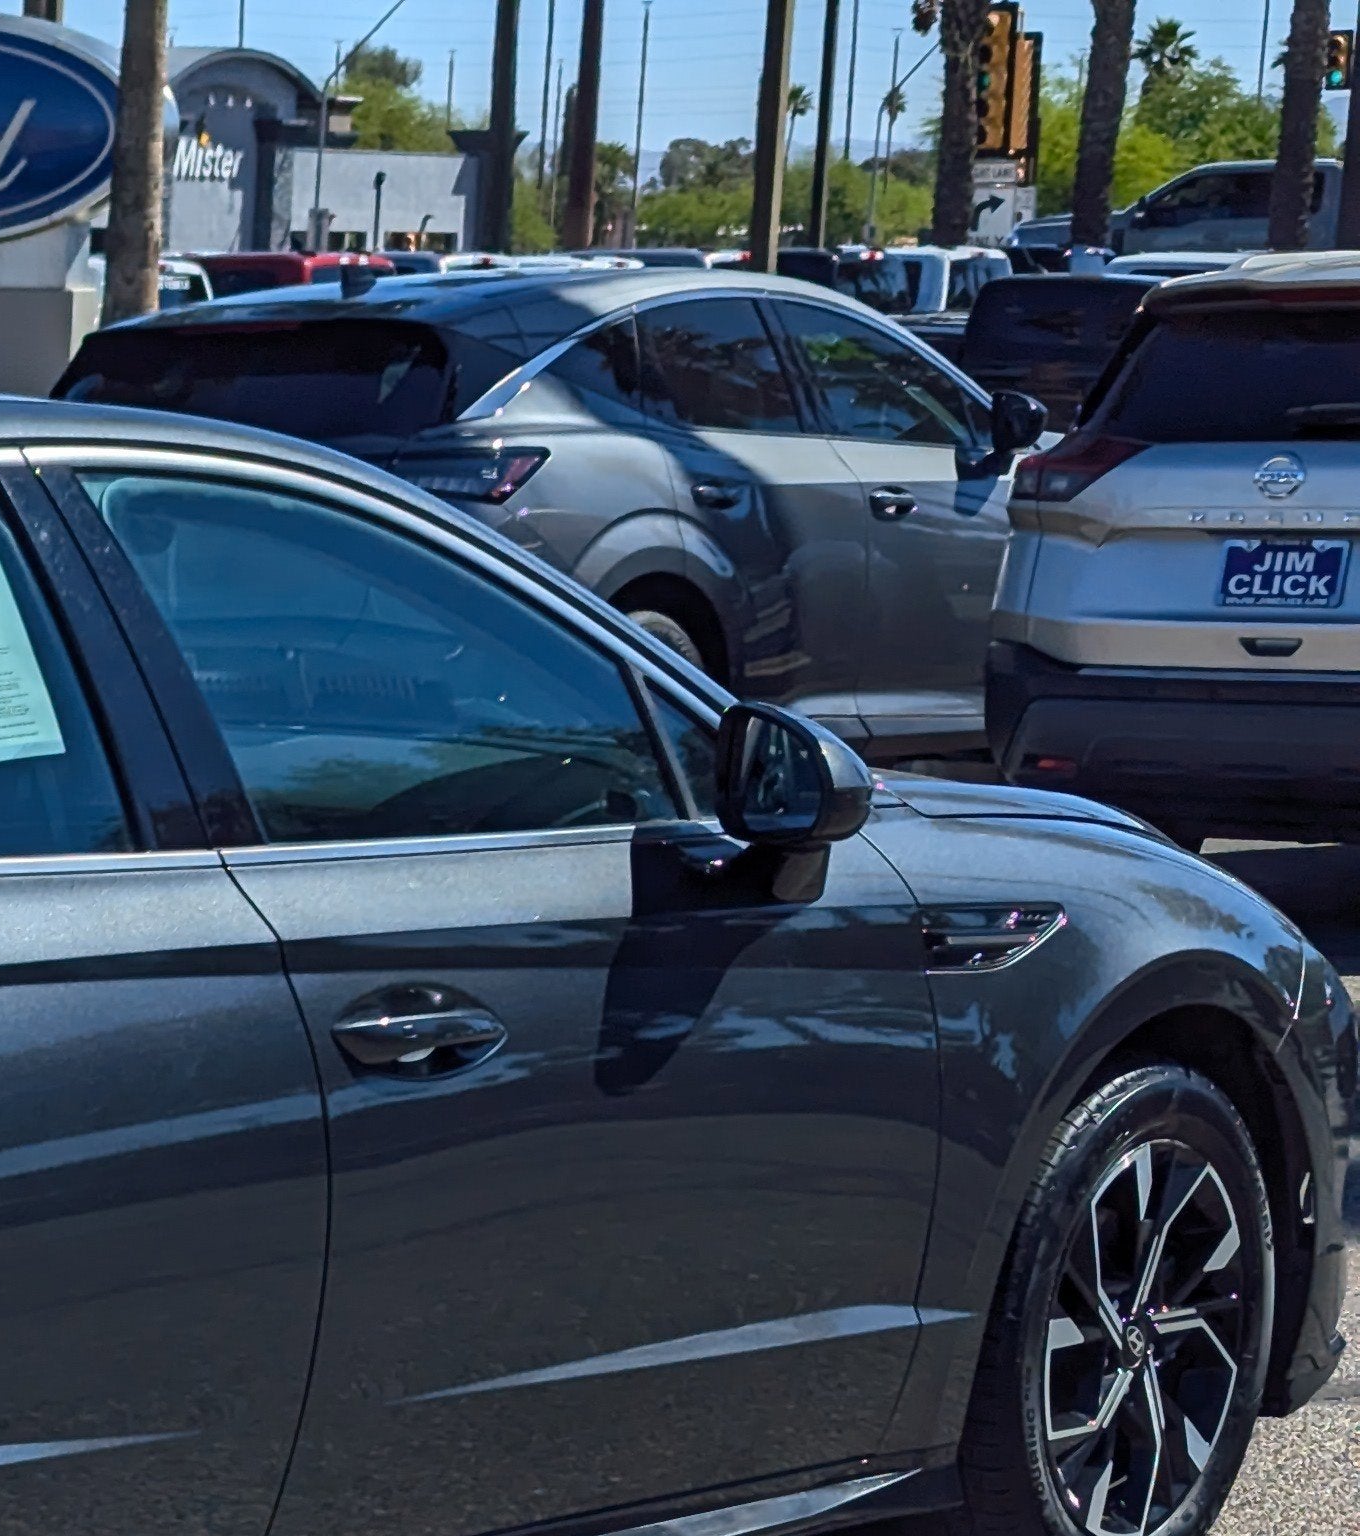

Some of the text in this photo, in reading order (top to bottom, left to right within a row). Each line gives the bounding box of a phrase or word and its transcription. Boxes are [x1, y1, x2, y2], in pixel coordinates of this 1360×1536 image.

[172, 136, 244, 180] Mister
[1253, 551, 1316, 573] JIM
[1228, 574, 1332, 596] CLICK
